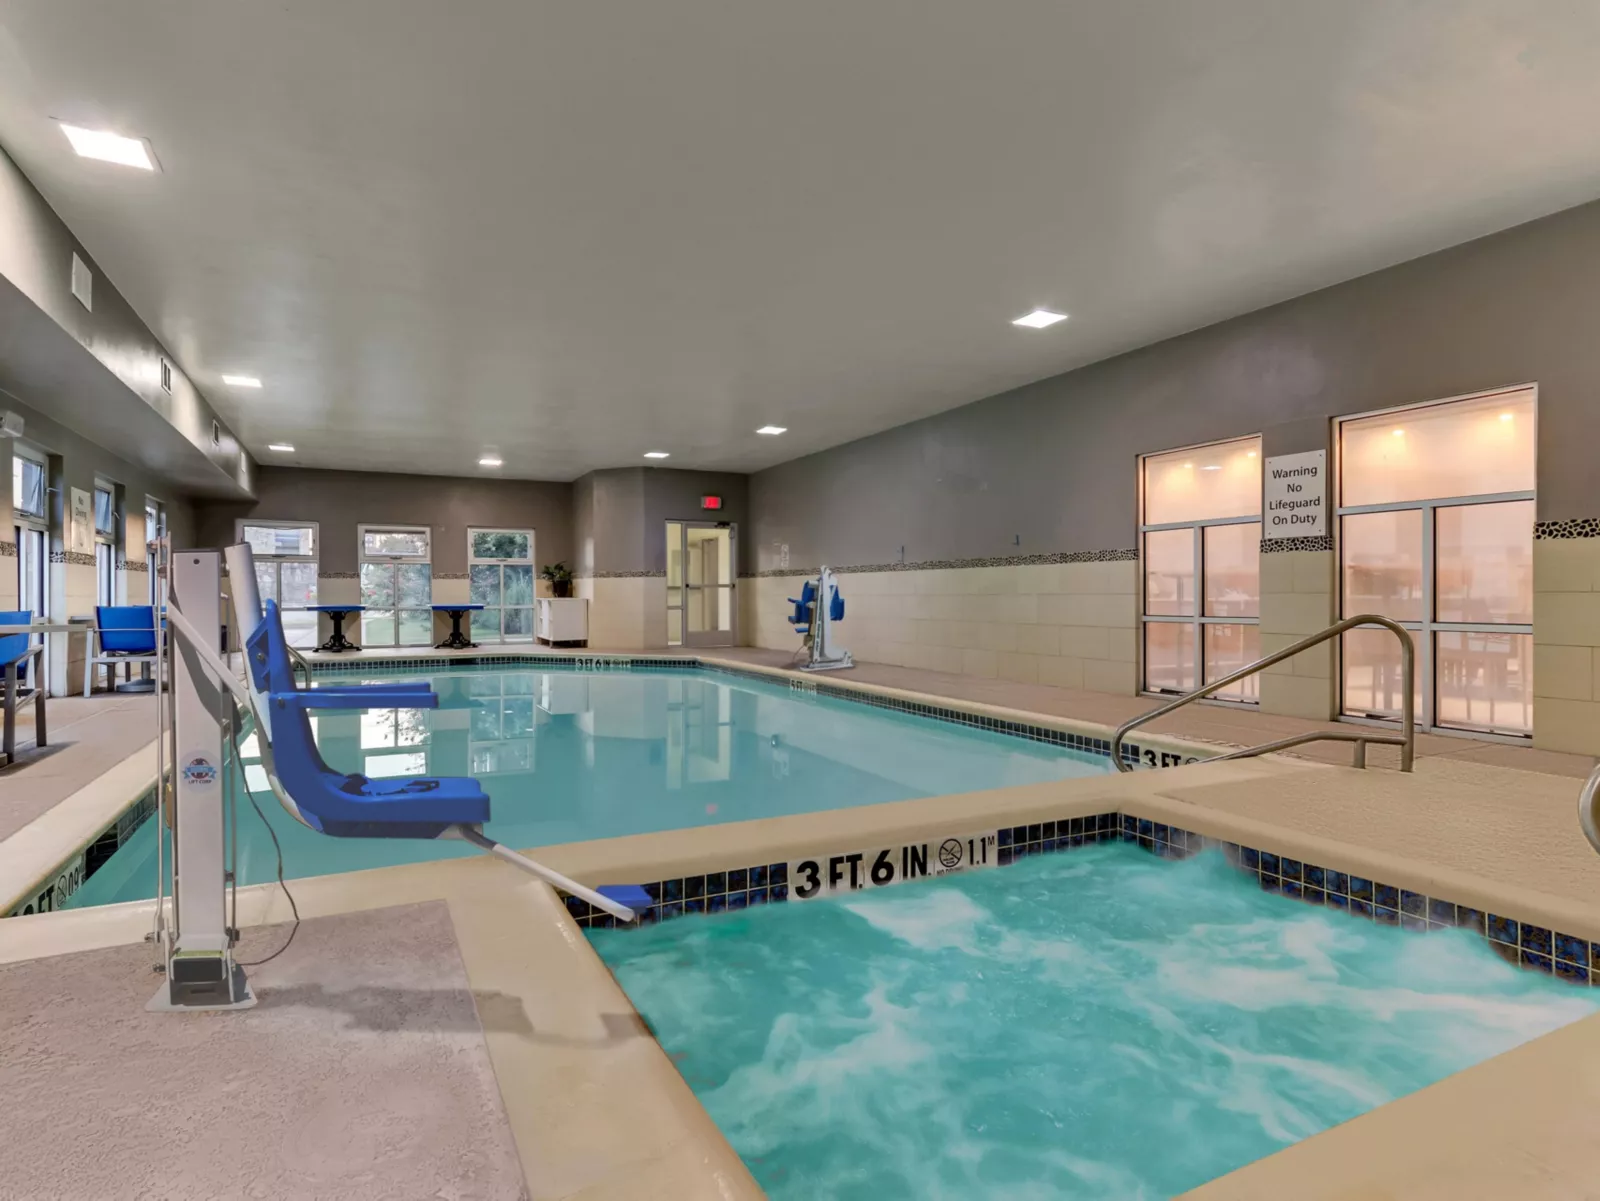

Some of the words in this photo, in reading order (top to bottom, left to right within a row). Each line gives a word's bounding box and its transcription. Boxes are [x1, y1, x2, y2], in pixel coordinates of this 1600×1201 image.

[1272, 466, 1318, 479] Warning
[1287, 483, 1302, 493] No
[1269, 496, 1320, 511] Lifeguard
[1272, 515, 1288, 526] On
[1291, 514, 1317, 526] Duty
[1144, 750, 1157, 767] 3
[1162, 752, 1182, 768] FT
[795, 861, 821, 898] 3
[871, 849, 895, 886] 6
[38, 884, 54, 914] FT
